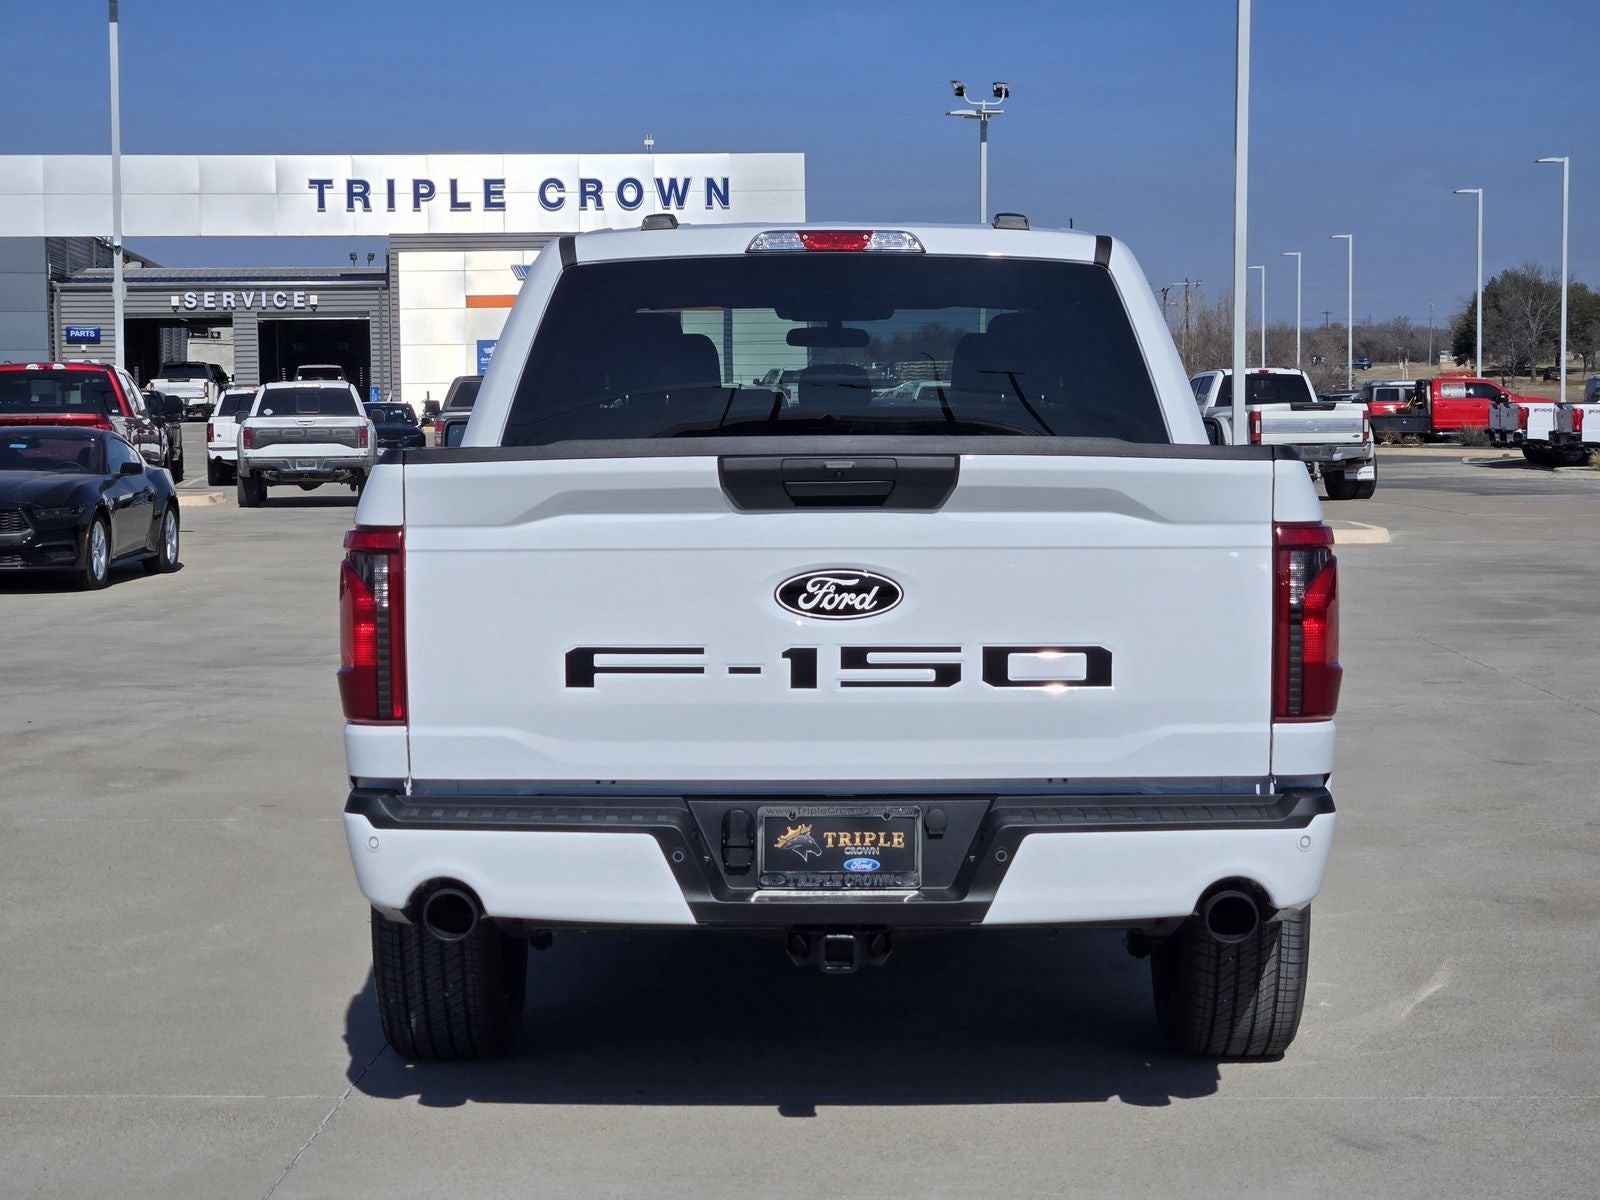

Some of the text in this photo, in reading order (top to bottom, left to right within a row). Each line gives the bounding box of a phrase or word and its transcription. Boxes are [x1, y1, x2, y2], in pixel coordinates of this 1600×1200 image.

[308, 177, 731, 212] TRIPLE CROWN
[183, 290, 306, 310] SERVICE
[70, 330, 95, 338] PARTS
[797, 576, 880, 611] Ford
[565, 645, 1112, 689] F-150
[823, 832, 904, 848] TRIPLE
[843, 846, 880, 856] CROWN
[851, 860, 874, 870] Ford
[785, 873, 894, 888] TRIPLE CROWN
